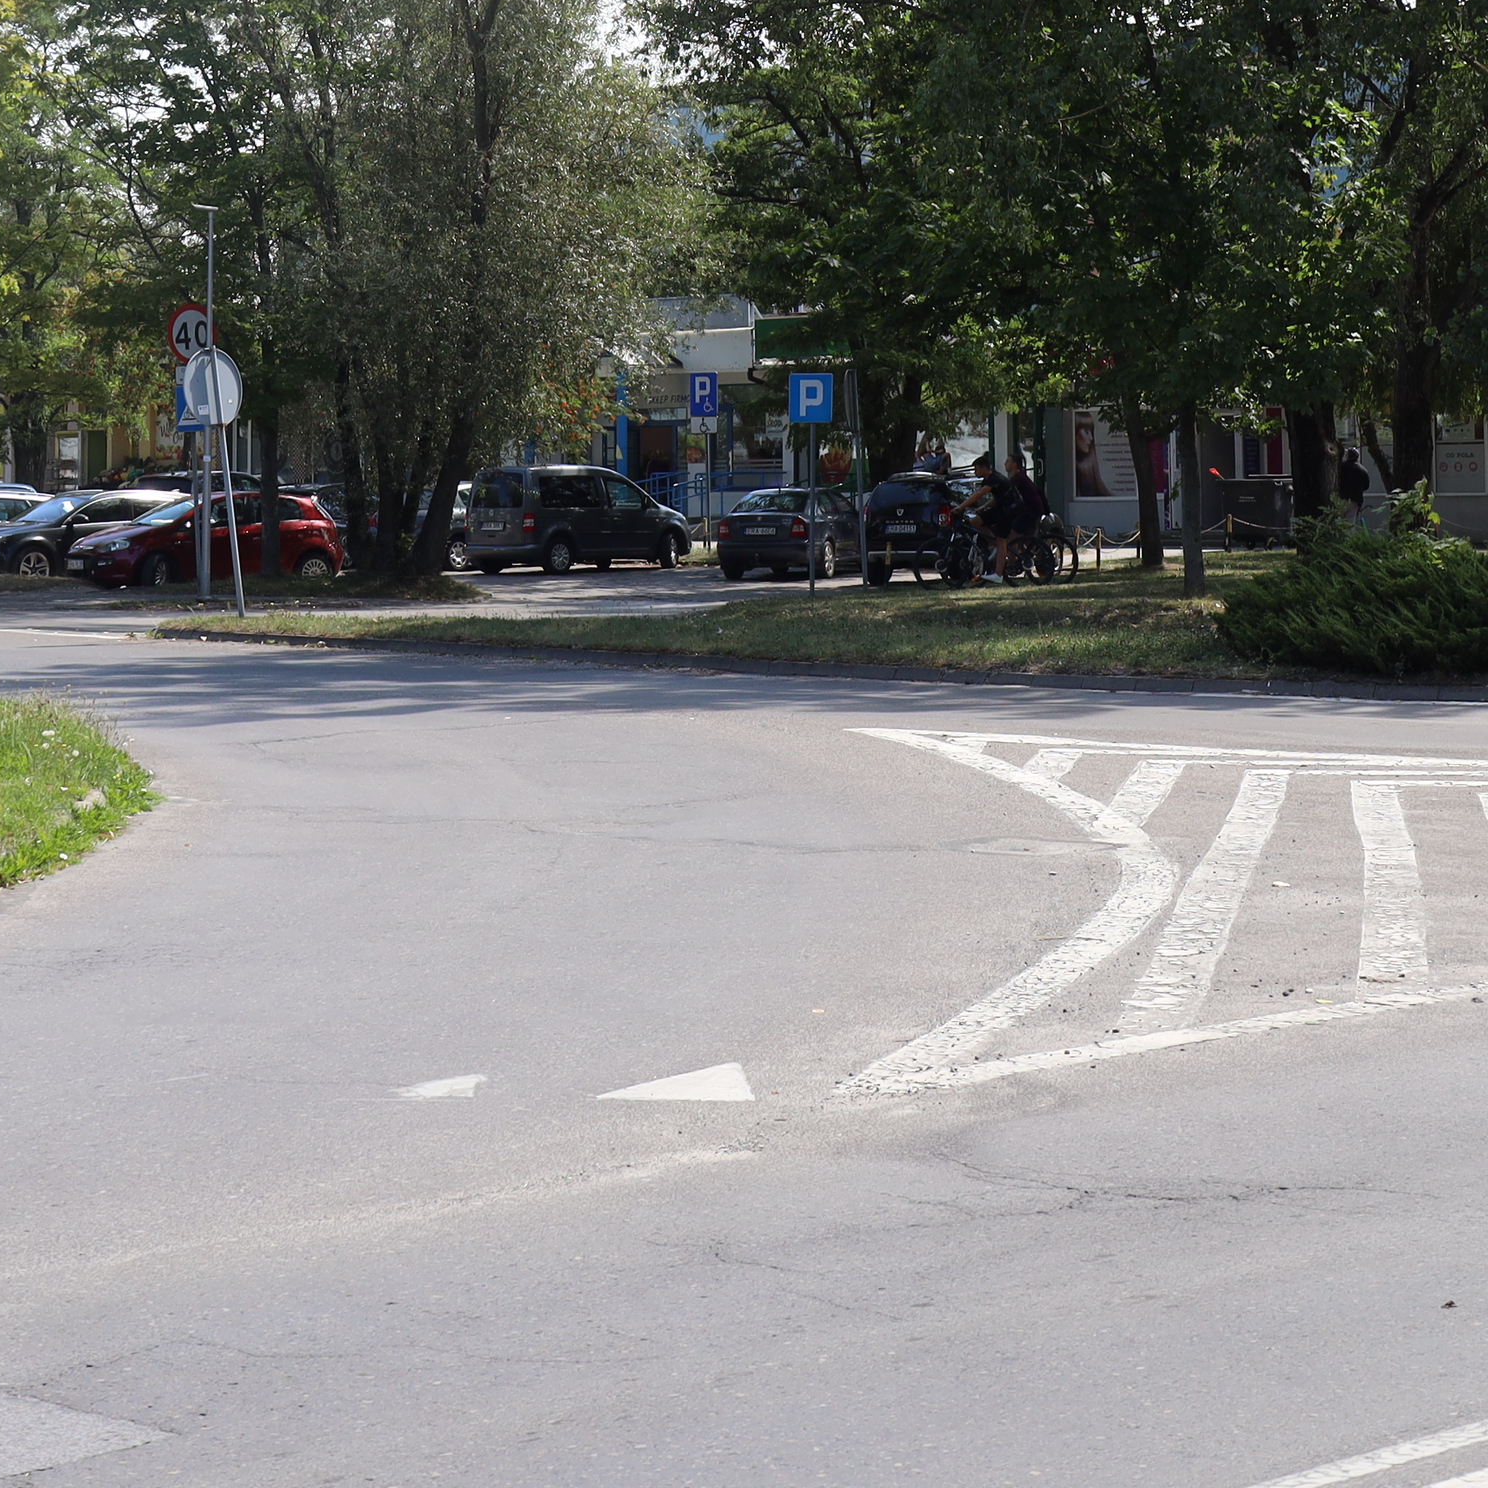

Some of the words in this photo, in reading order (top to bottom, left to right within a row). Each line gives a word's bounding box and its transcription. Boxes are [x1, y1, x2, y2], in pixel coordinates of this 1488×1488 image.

[175, 320, 207, 350] 40
[695, 376, 711, 403] P
[799, 379, 824, 417] P
